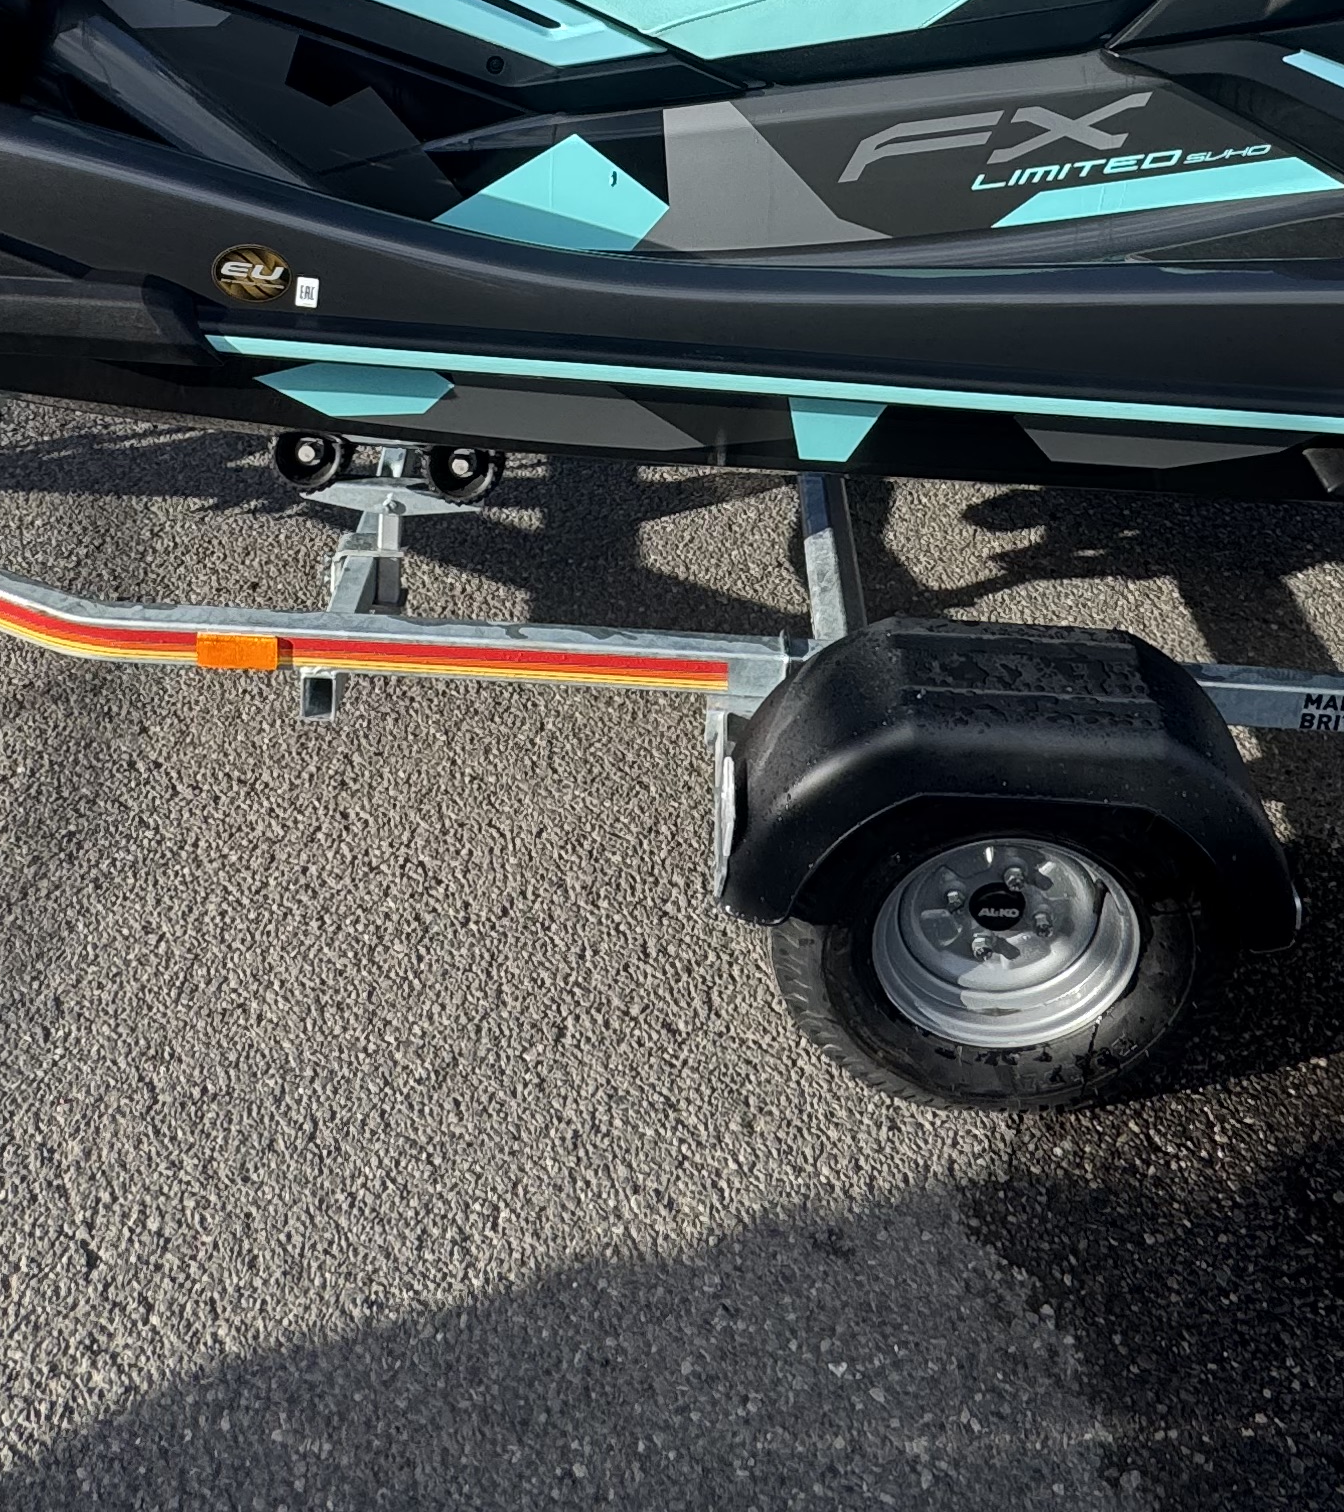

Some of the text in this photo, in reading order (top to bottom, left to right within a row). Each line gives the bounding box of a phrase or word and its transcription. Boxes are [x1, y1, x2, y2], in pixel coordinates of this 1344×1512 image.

[838, 91, 1154, 184] FX
[971, 149, 1183, 191] LIMITED
[221, 261, 284, 281] EU
